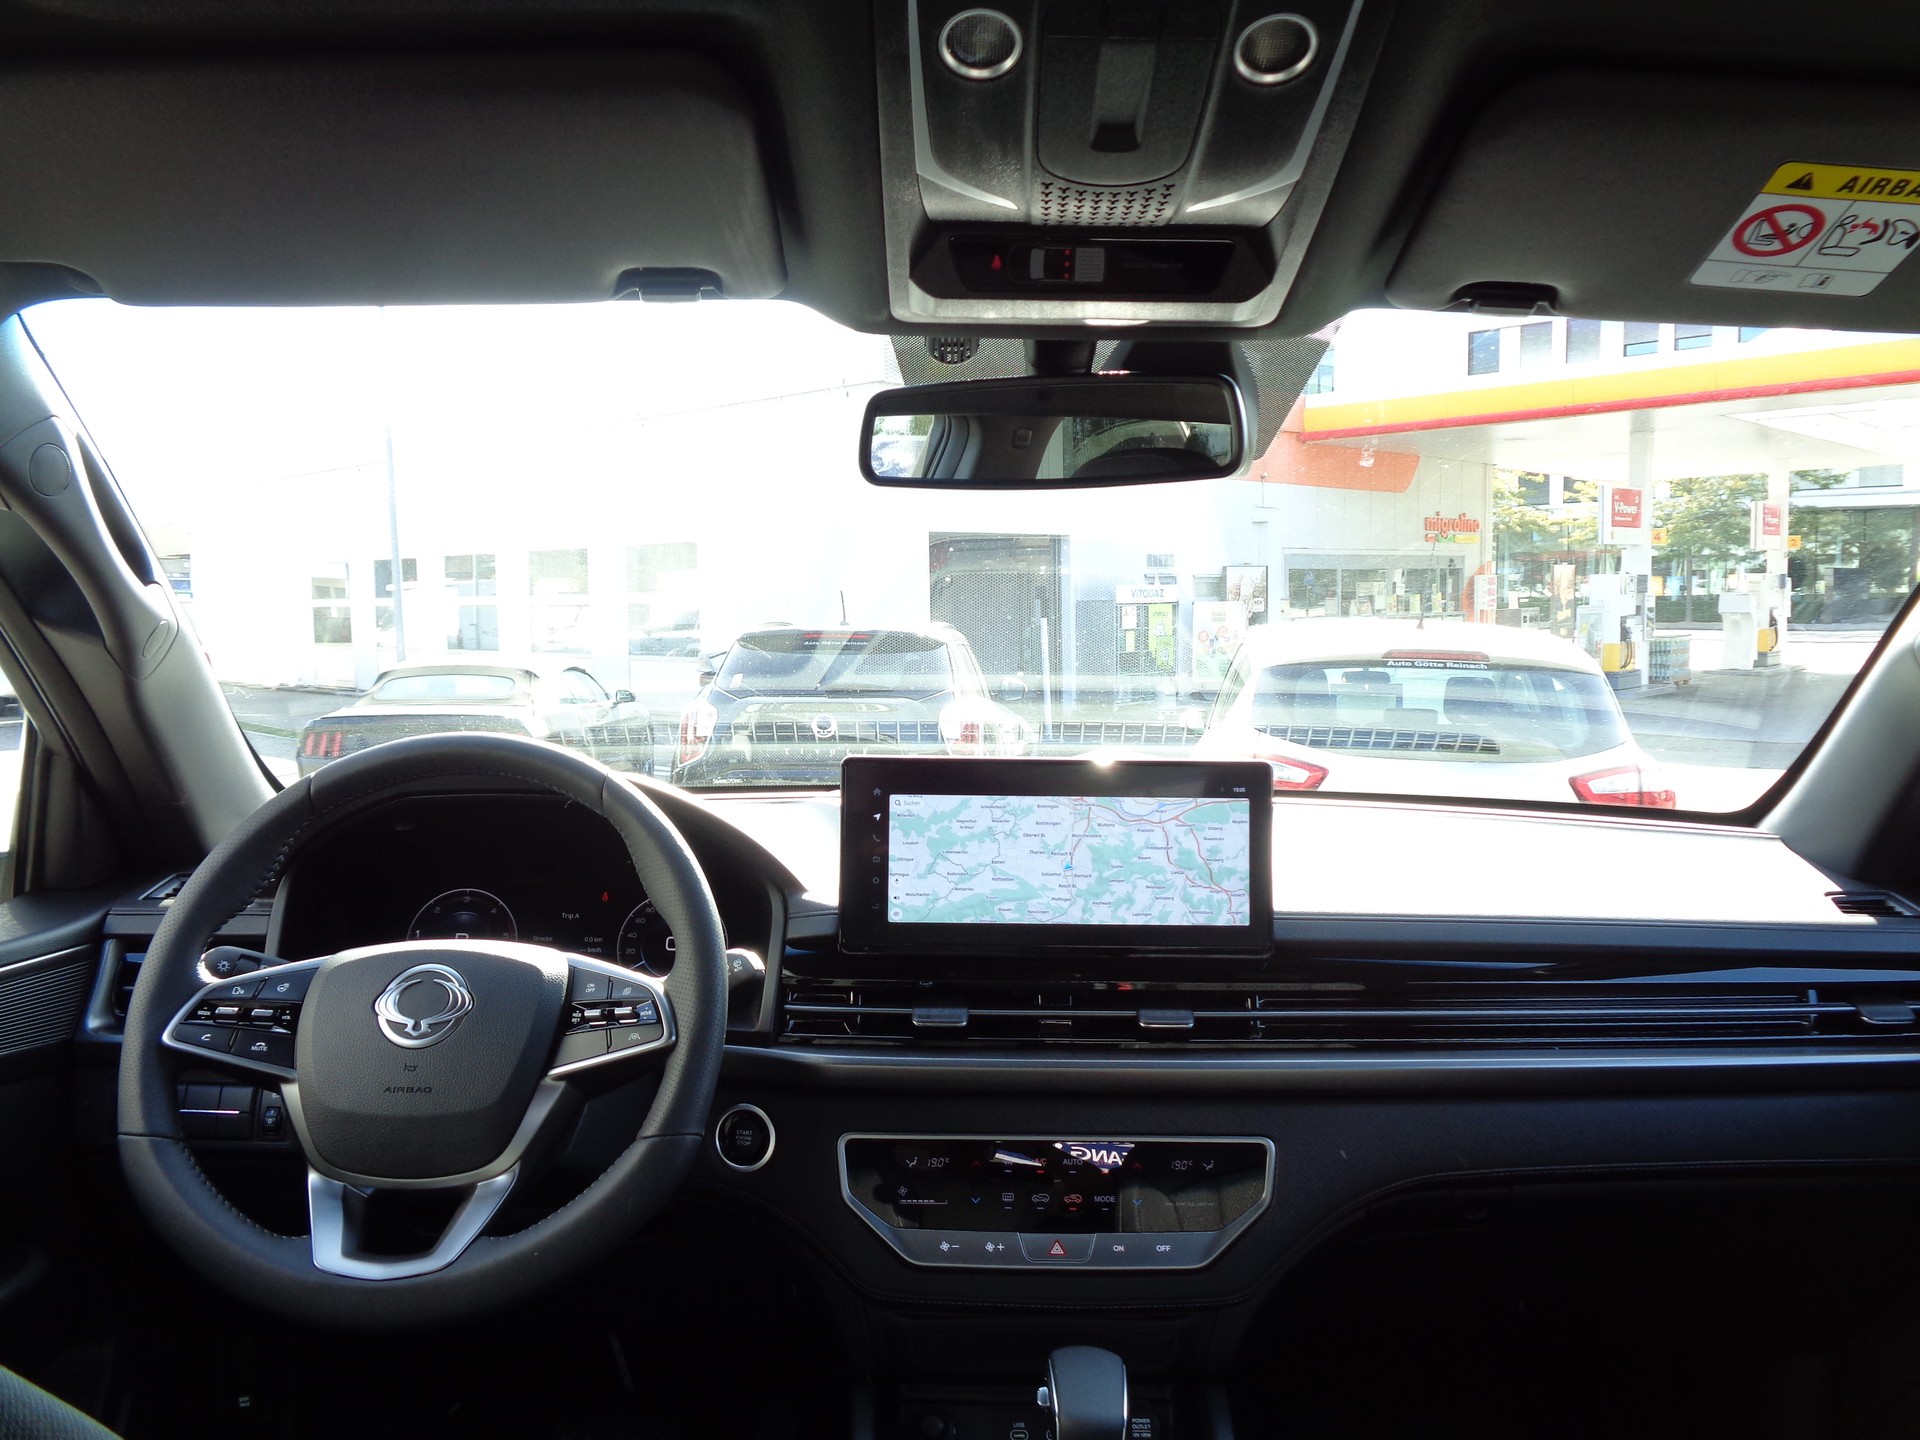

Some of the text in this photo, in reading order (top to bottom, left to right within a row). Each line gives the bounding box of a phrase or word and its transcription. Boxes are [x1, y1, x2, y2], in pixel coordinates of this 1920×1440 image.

[1653, 532, 1661, 541] 4
[1791, 538, 1798, 546] 2
[1414, 660, 1444, 668] Götte
[1446, 662, 1488, 670] Reinach
[561, 912, 574, 920] Trip
[384, 1086, 433, 1094] AIRBAG
[1062, 1158, 1083, 1166] AUTO
[1094, 1195, 1116, 1203] MODE
[1113, 1244, 1125, 1252] ON
[1156, 1244, 1172, 1252] OFF
